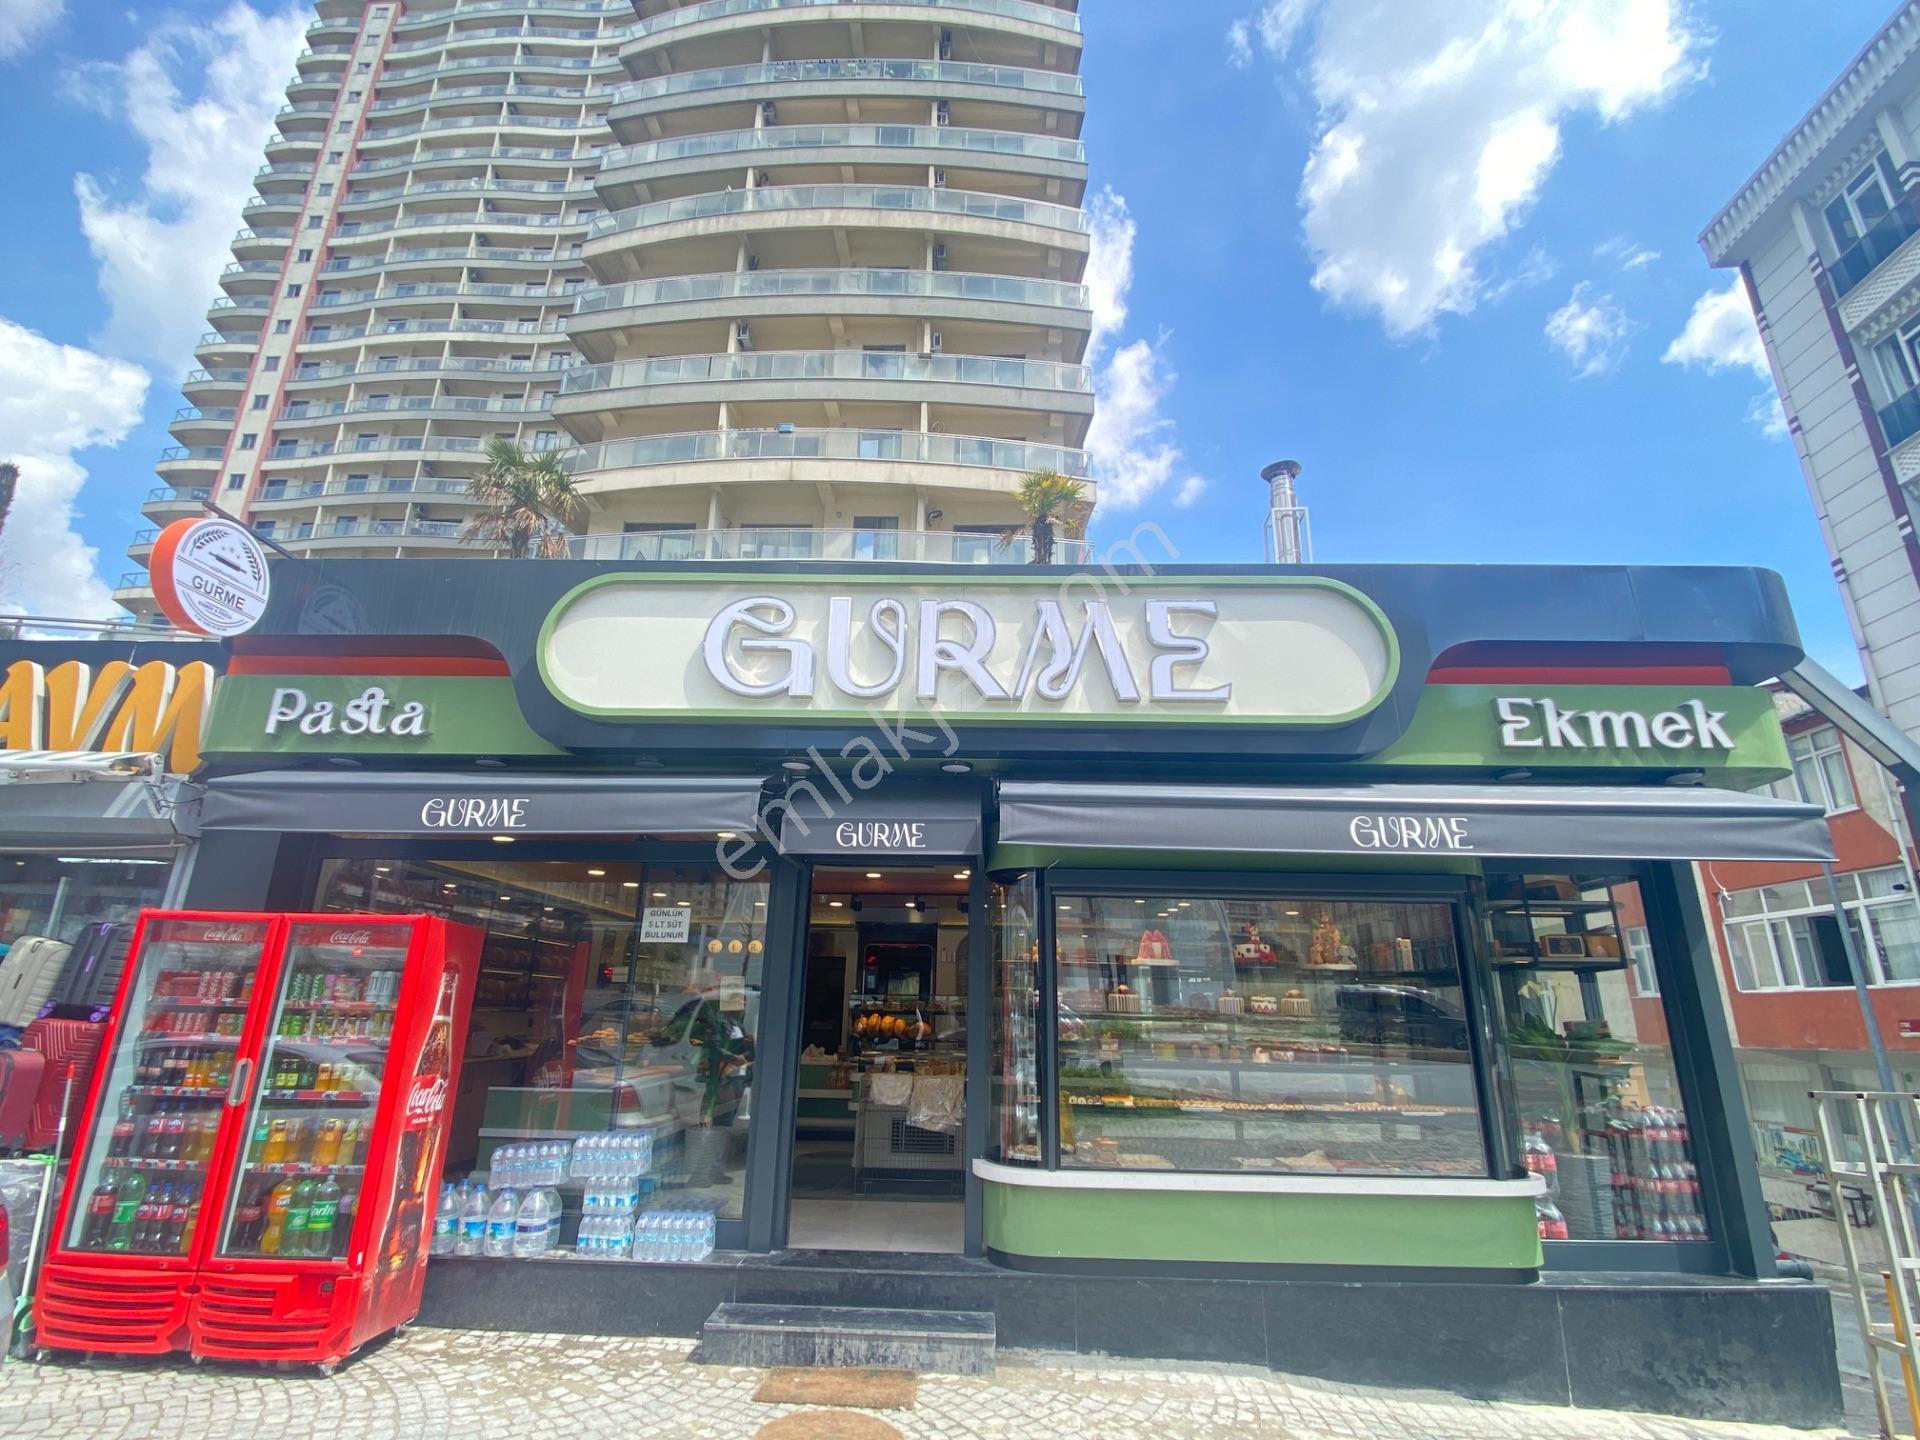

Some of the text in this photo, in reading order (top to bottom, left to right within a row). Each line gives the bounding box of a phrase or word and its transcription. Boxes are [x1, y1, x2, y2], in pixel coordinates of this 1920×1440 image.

[192, 575, 246, 611] GURME
[702, 597, 1231, 702] GURME
[265, 687, 427, 735] Pasta
[1496, 697, 1736, 749] Ekmek
[421, 798, 530, 828] GURME
[835, 822, 926, 848] GURME
[1350, 815, 1474, 849] GURME
[644, 931, 684, 939] BULUNUR
